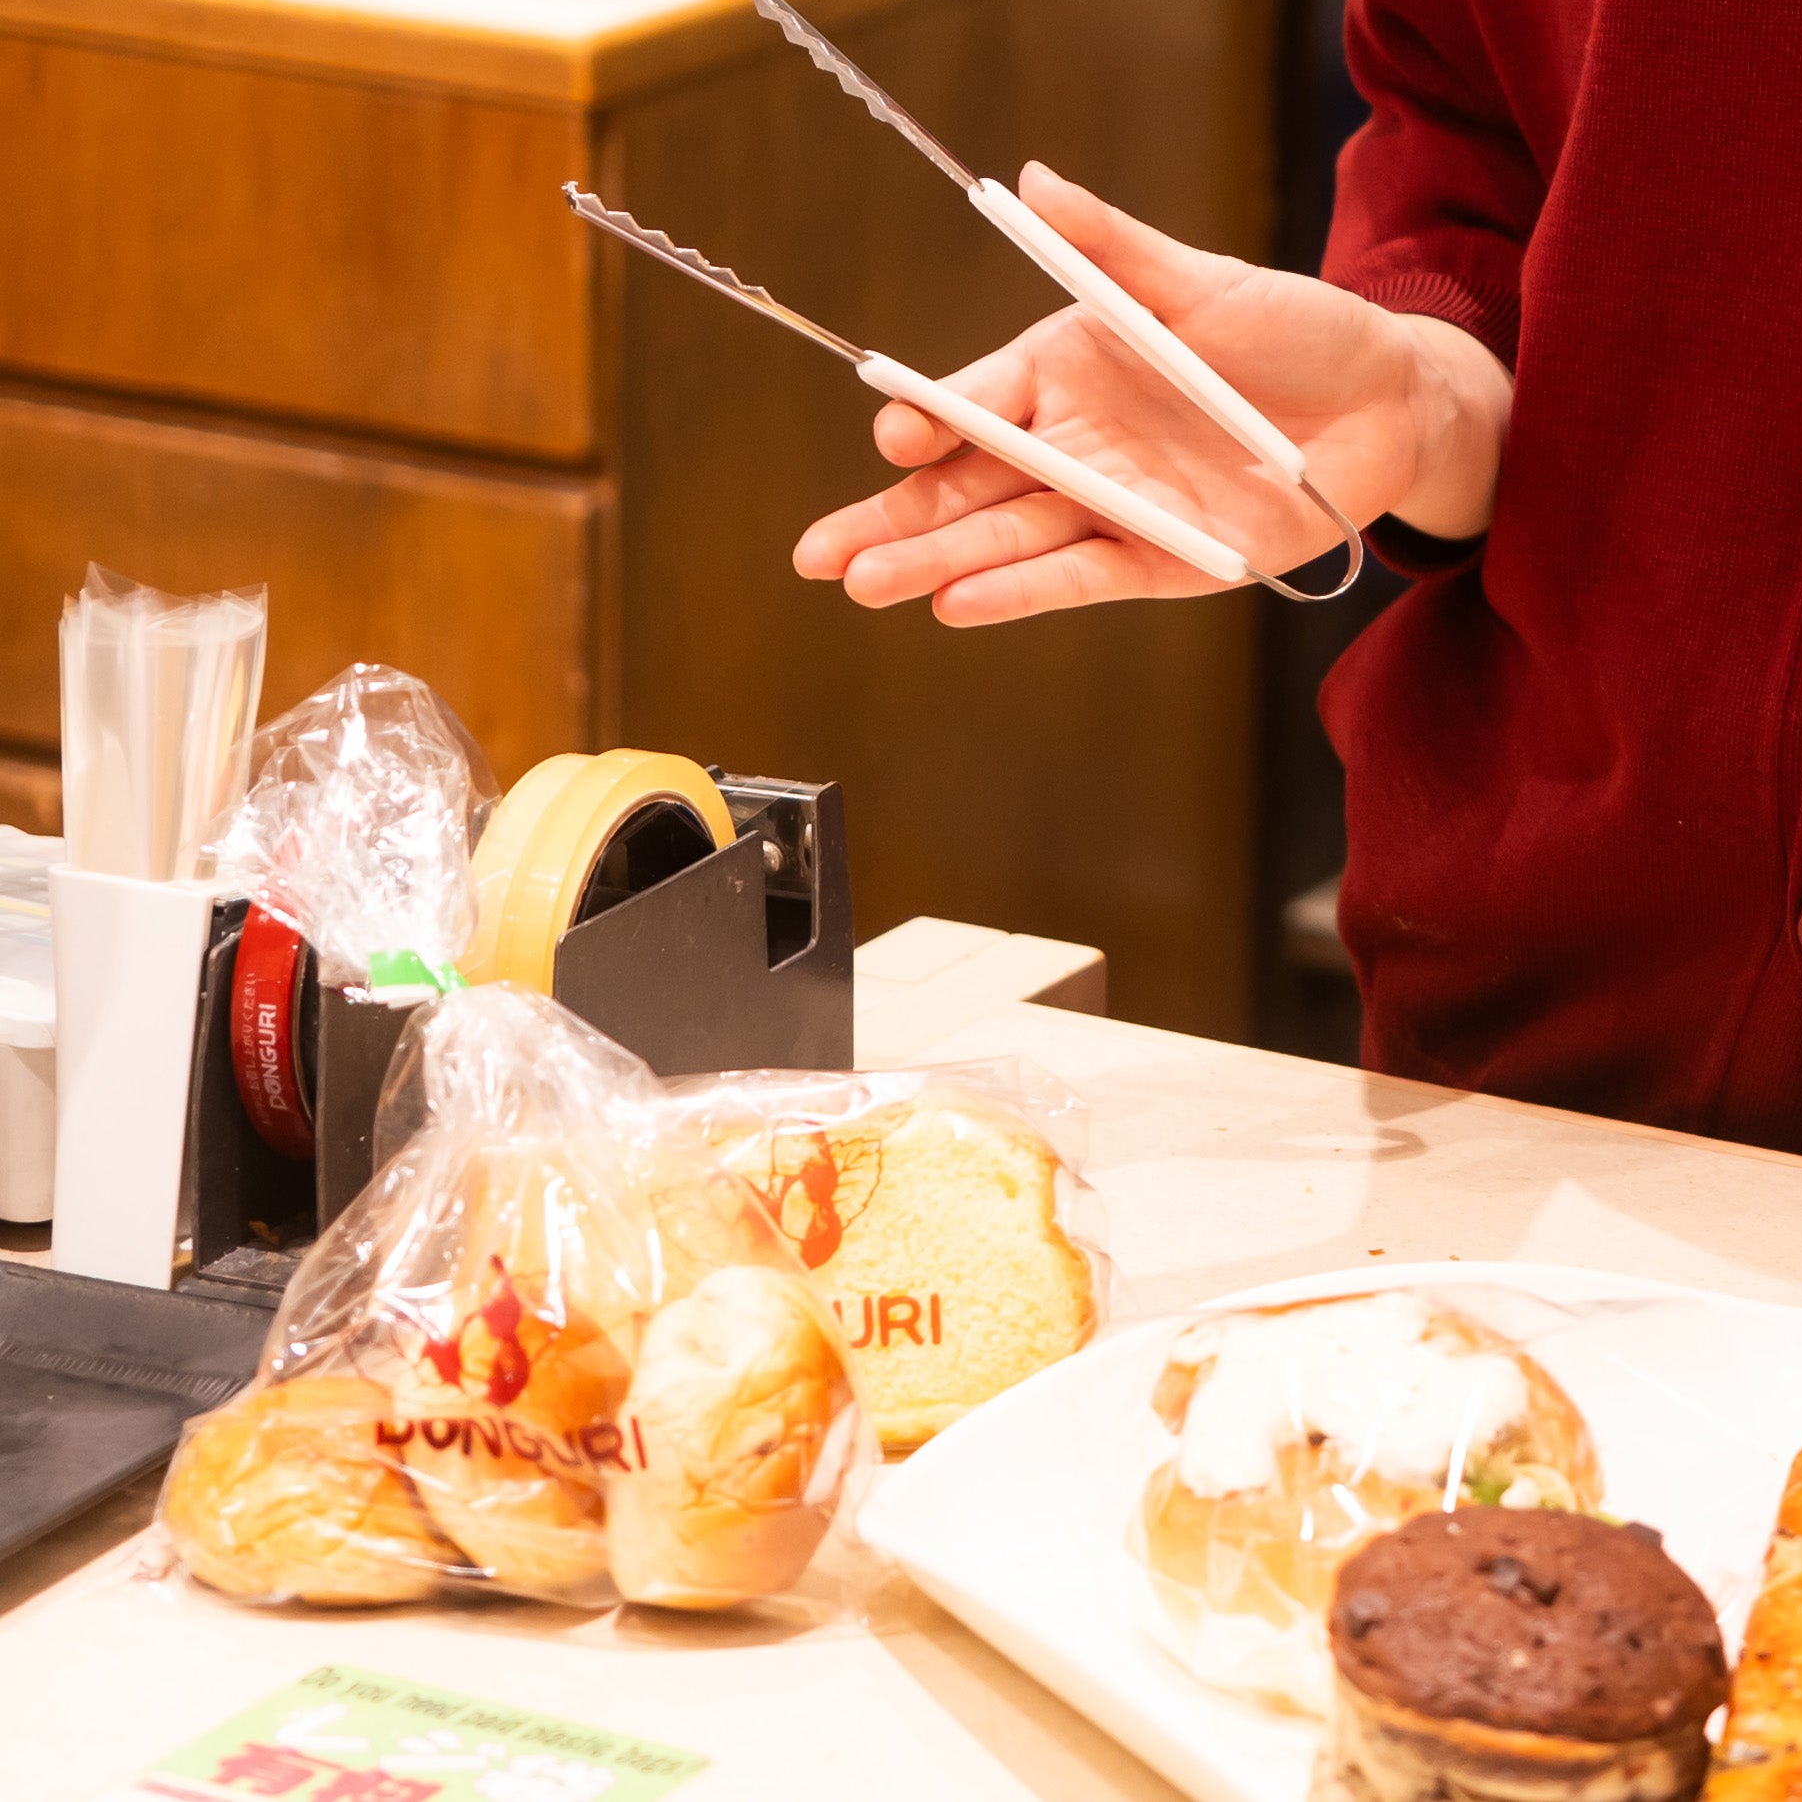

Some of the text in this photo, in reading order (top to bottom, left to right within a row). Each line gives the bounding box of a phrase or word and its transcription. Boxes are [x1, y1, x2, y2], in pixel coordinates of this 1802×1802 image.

[258, 1003, 287, 1110] DONGURI
[376, 1415, 647, 1471] DONGURI
[340, 1682, 397, 1703] you
[396, 1695, 470, 1720] need
